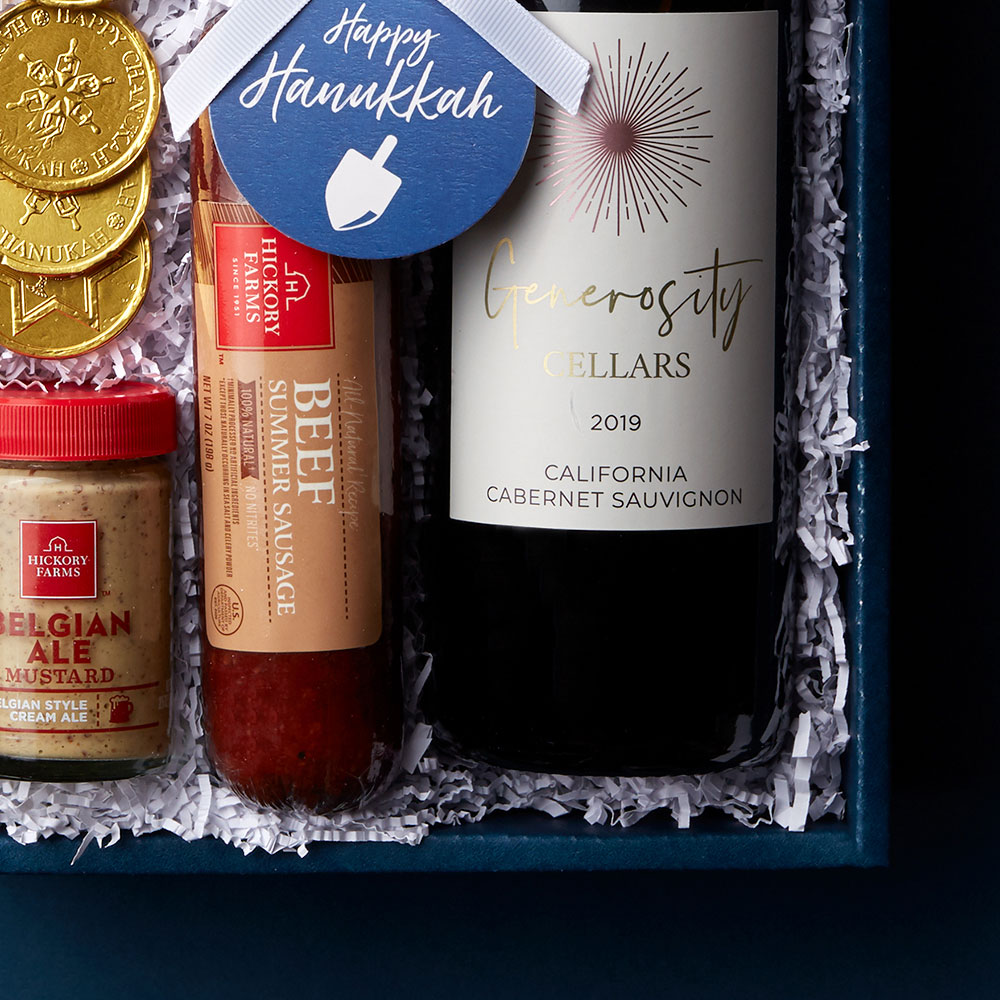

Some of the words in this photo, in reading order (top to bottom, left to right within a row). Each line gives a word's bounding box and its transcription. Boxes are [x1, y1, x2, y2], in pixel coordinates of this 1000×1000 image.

[56, 8, 128, 48] HAPPY
[324, 3, 440, 67] Happy
[239, 43, 503, 123] Hanukkah
[244, 252, 260, 323] FARMS
[261, 237, 280, 336] HICKORY
[484, 236, 763, 352] Generosity
[543, 351, 691, 379] CELLARS
[202, 375, 212, 394] NET
[203, 396, 212, 412] WT
[240, 388, 253, 418] 100%
[204, 423, 213, 436] OZ
[590, 414, 642, 431] 2019
[268, 379, 291, 494] SUMMER
[293, 377, 335, 505] BEEF
[204, 438, 214, 460] (198
[544, 464, 688, 483] CALIFORNIA
[245, 485, 256, 500] NO
[486, 485, 604, 508] CABERNET
[612, 487, 743, 509] SAUVIGNON
[28, 555, 88, 566] HICKORY
[273, 502, 296, 616] SAUSAGE
[36, 567, 81, 578] FARMS
[232, 602, 240, 620] U.S.
[27, 640, 92, 664] ALE
[5, 667, 115, 684] MUSTARD
[9, 711, 57, 723] CREAM
[61, 711, 88, 723] ALE
[45, 700, 88, 711] STYLE
